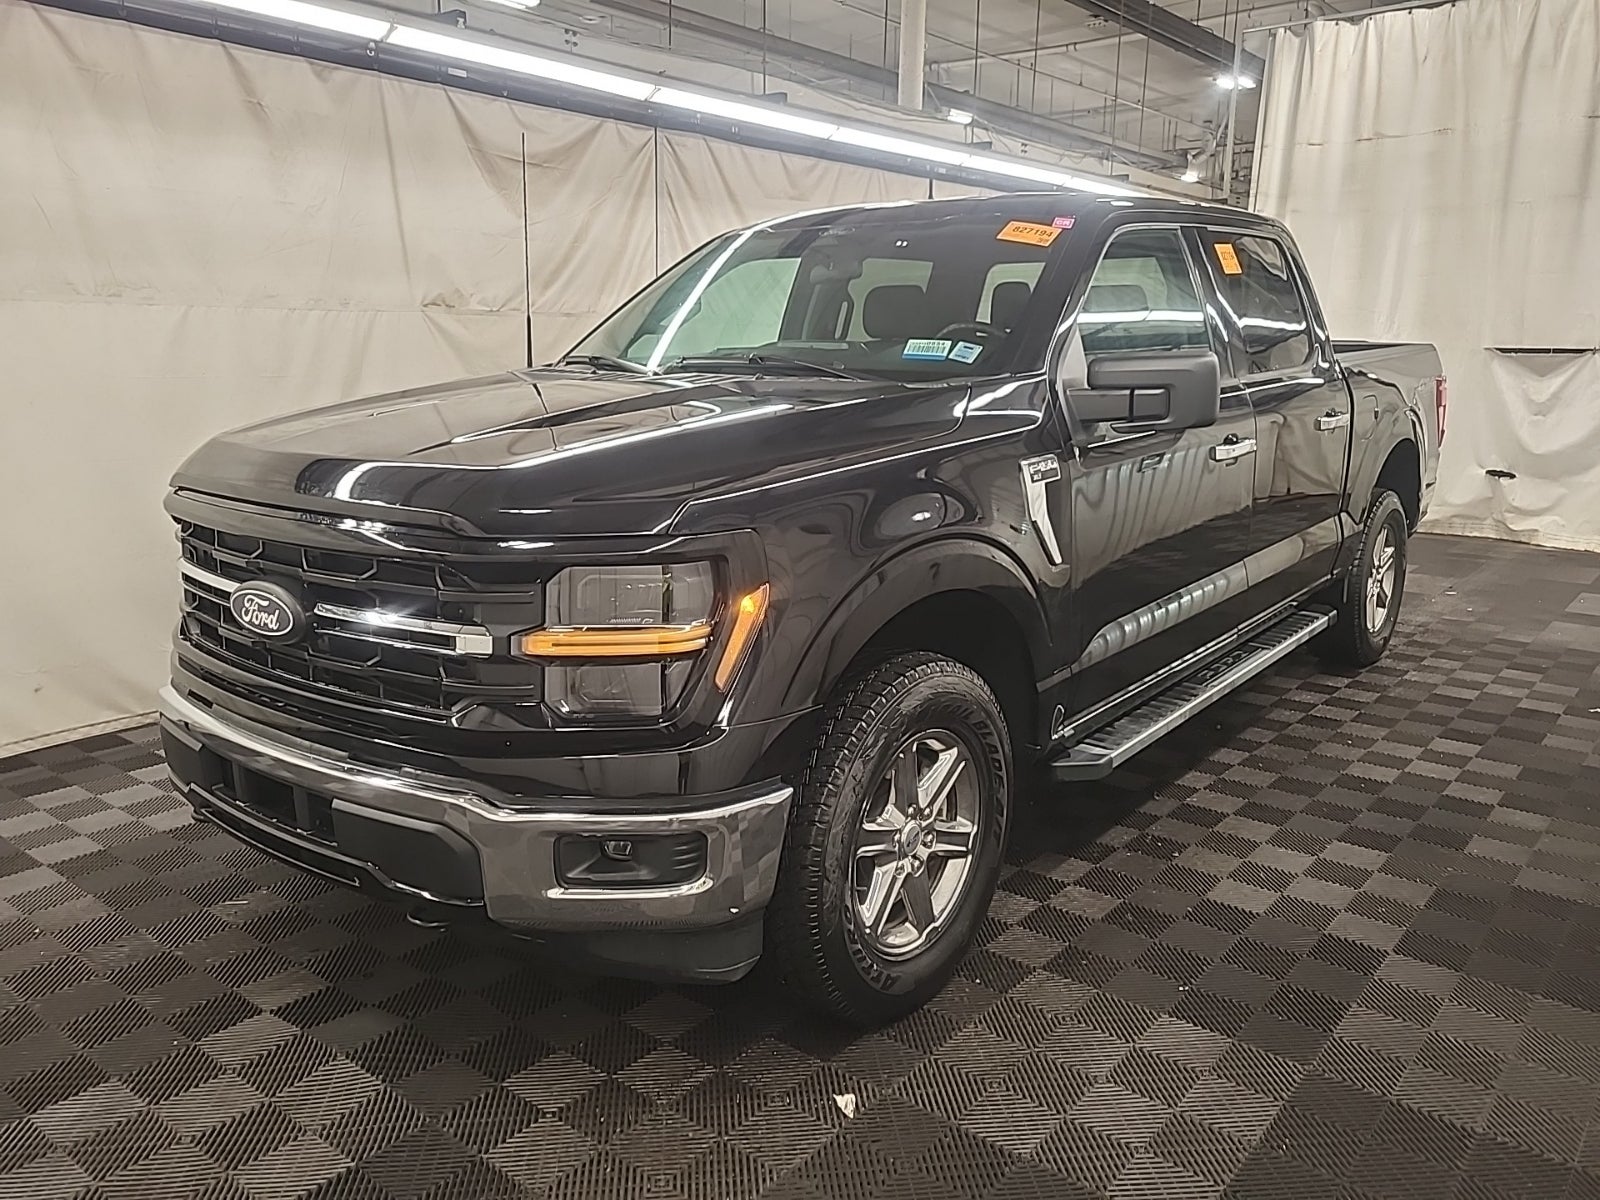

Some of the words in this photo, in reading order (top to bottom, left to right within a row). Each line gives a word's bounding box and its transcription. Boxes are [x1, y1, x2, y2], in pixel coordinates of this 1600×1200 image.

[1012, 226, 1054, 238] 827194
[241, 594, 280, 630] Ford
[972, 718, 1005, 790] BLADE
